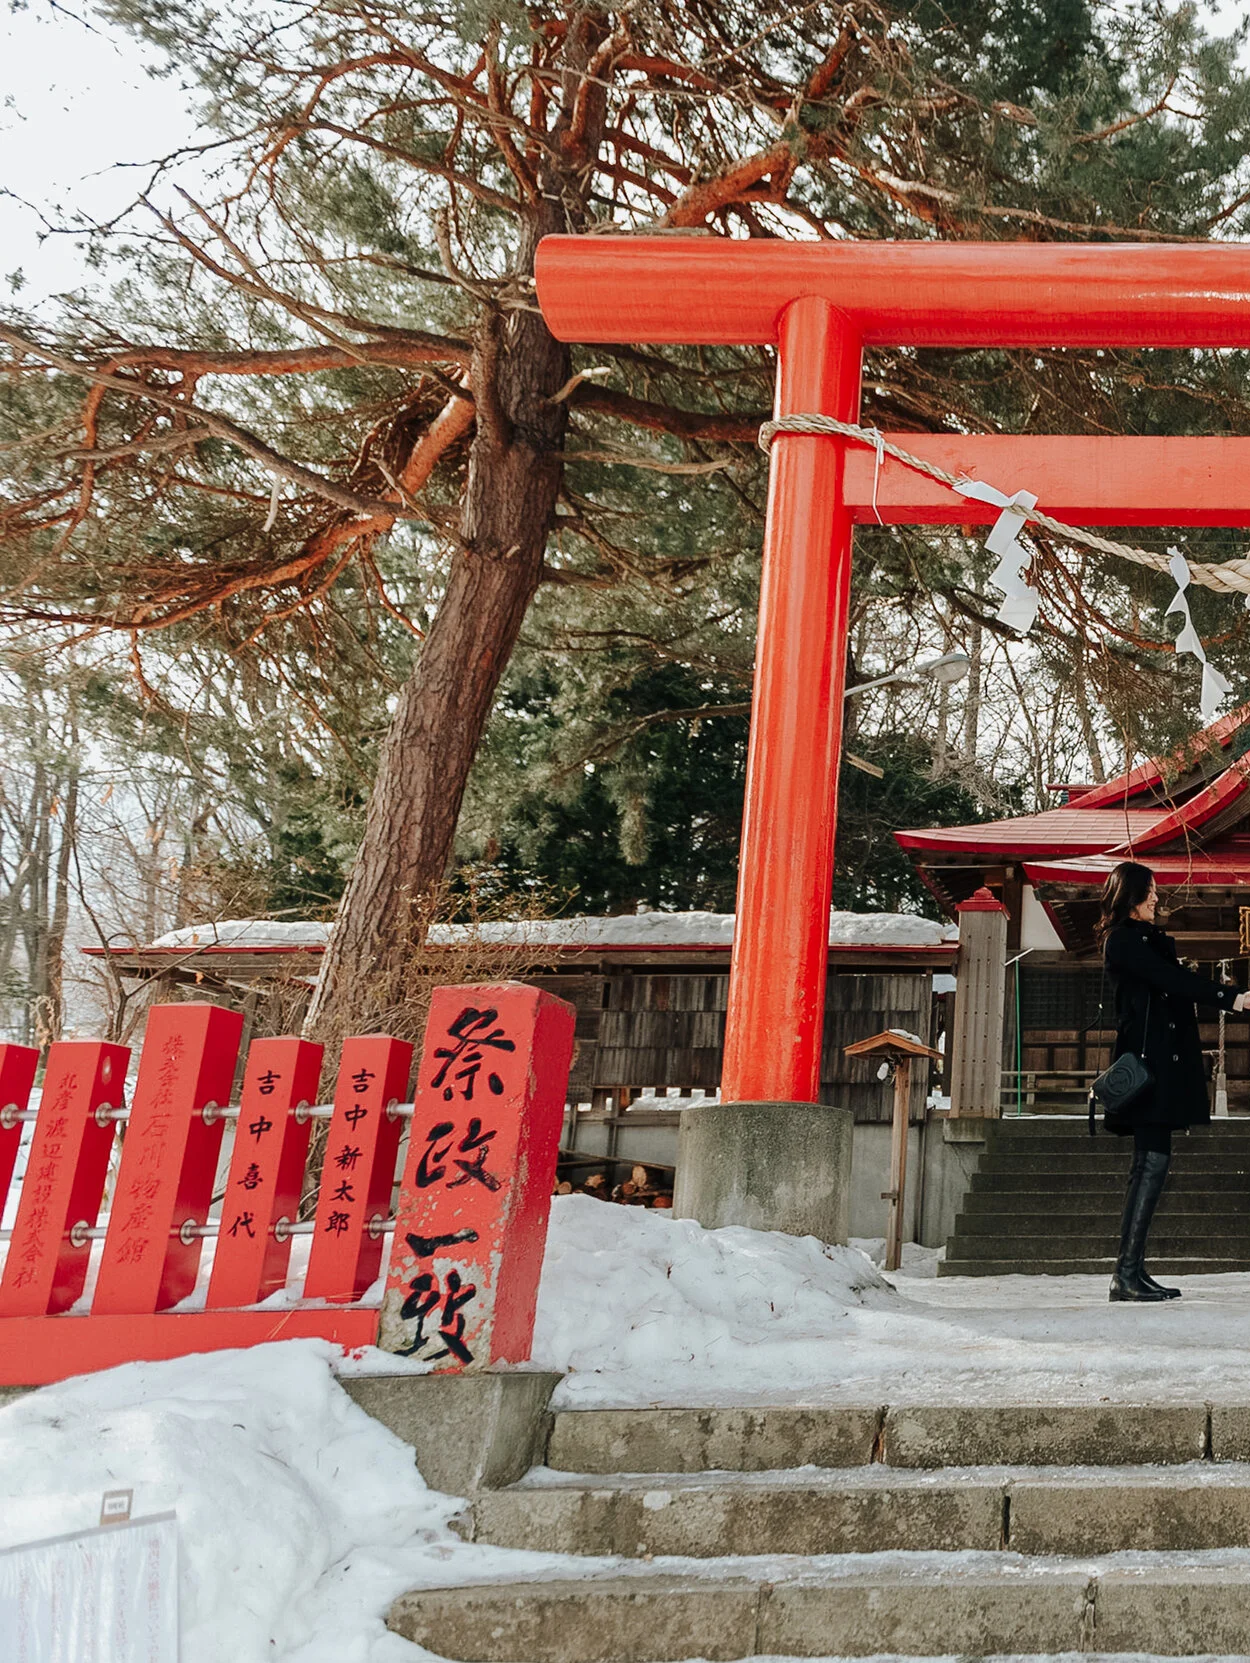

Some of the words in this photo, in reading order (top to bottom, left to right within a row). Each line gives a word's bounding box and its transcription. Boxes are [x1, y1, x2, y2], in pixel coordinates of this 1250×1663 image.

[227, 1069, 282, 1239] 吉中喜代
[324, 1067, 376, 1240] 吉中新太郎
